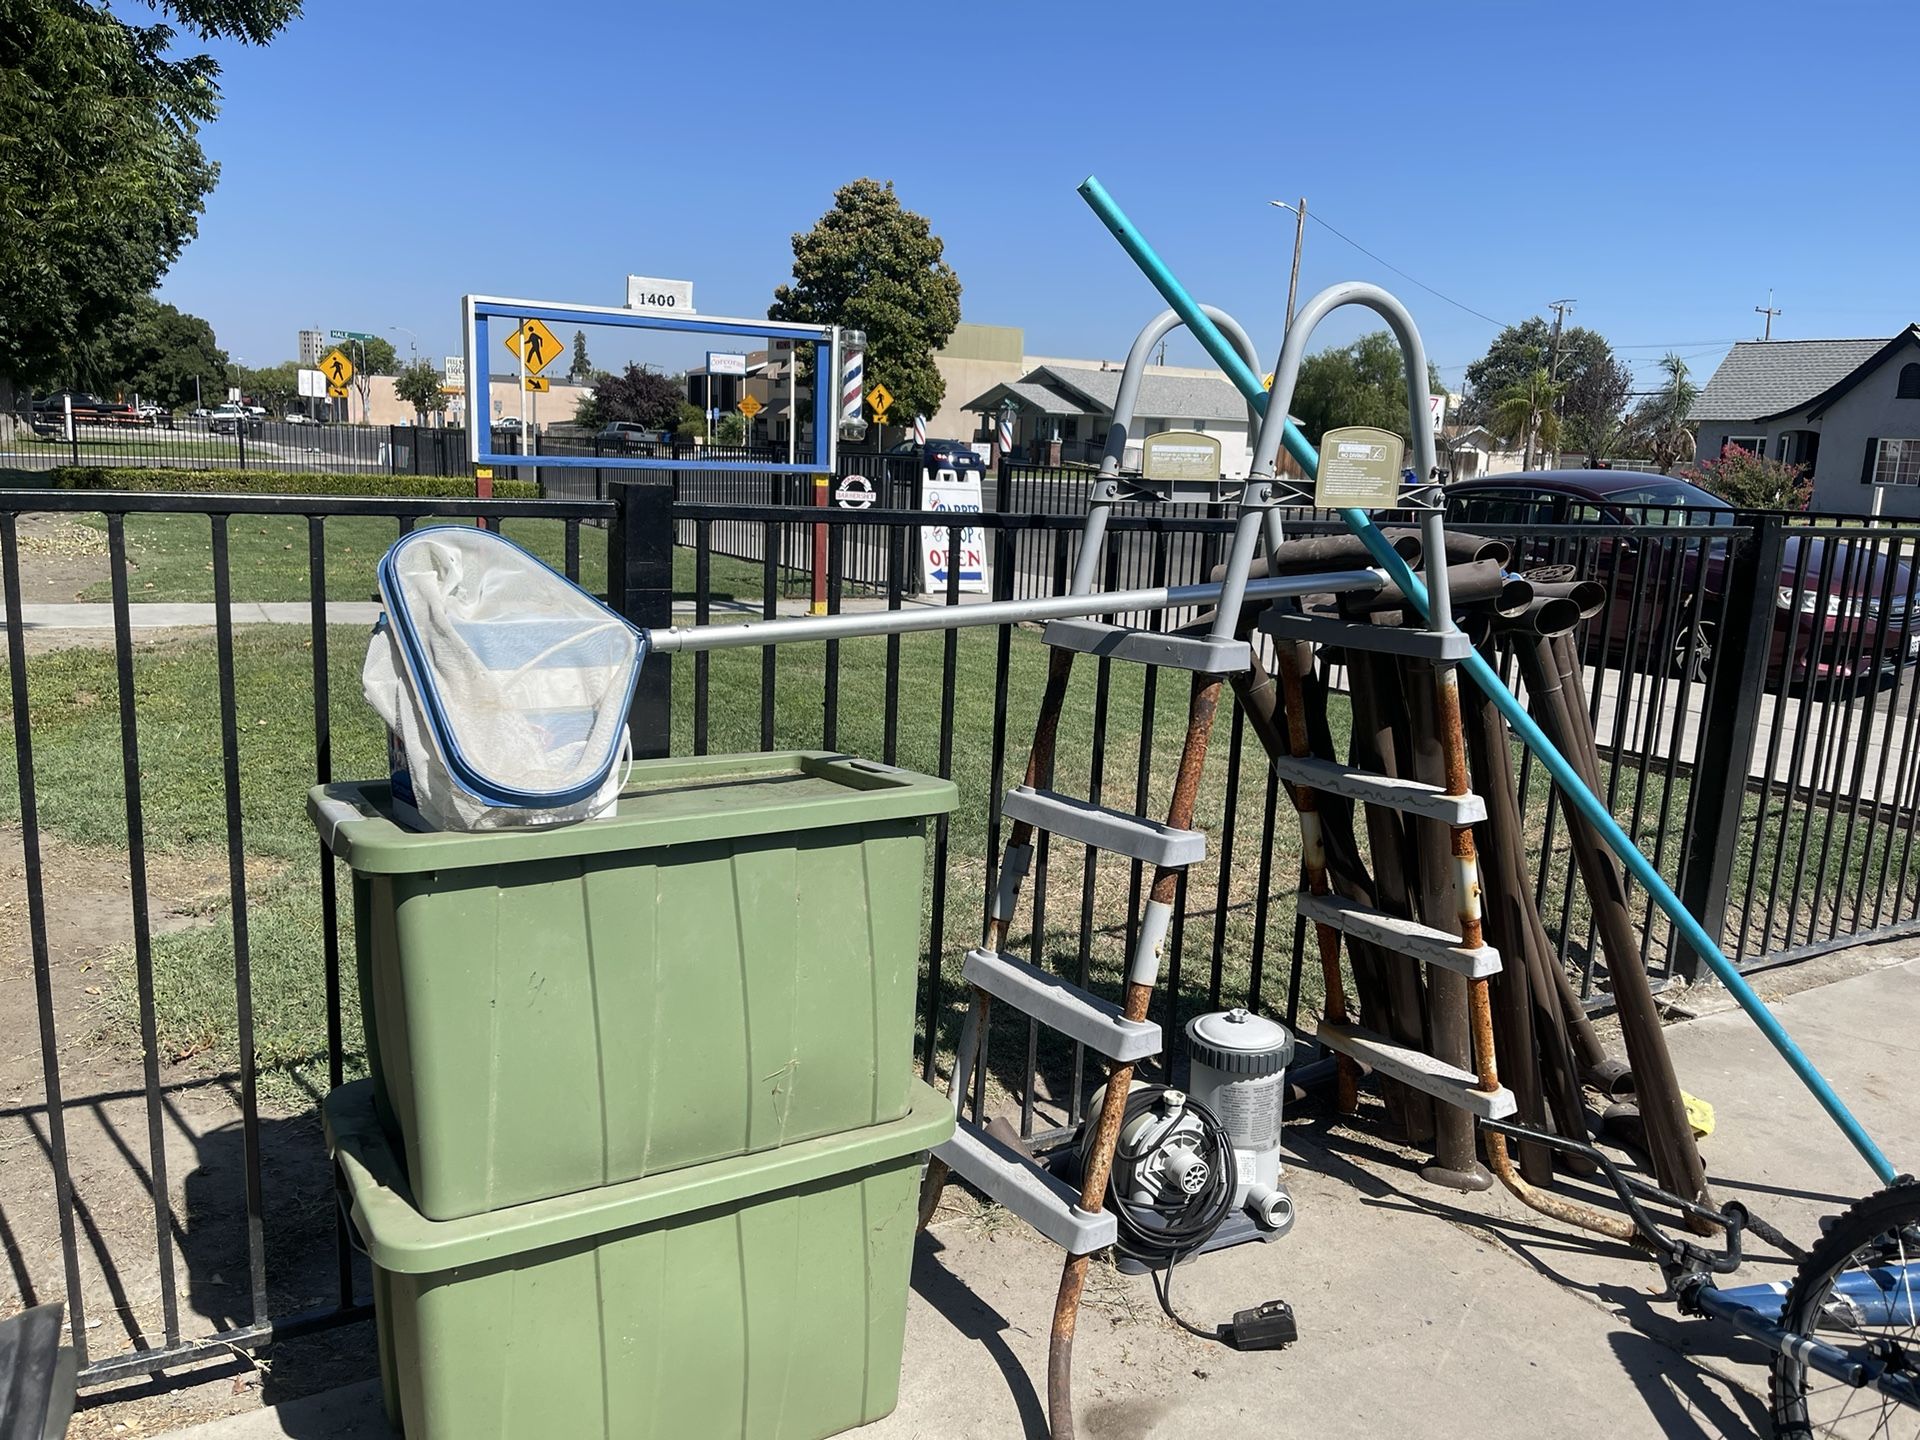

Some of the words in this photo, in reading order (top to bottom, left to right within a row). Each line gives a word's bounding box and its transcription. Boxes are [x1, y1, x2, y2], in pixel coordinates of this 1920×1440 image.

[640, 293, 675, 307] 1400
[332, 331, 349, 339] HALE
[945, 526, 975, 543] SOP
